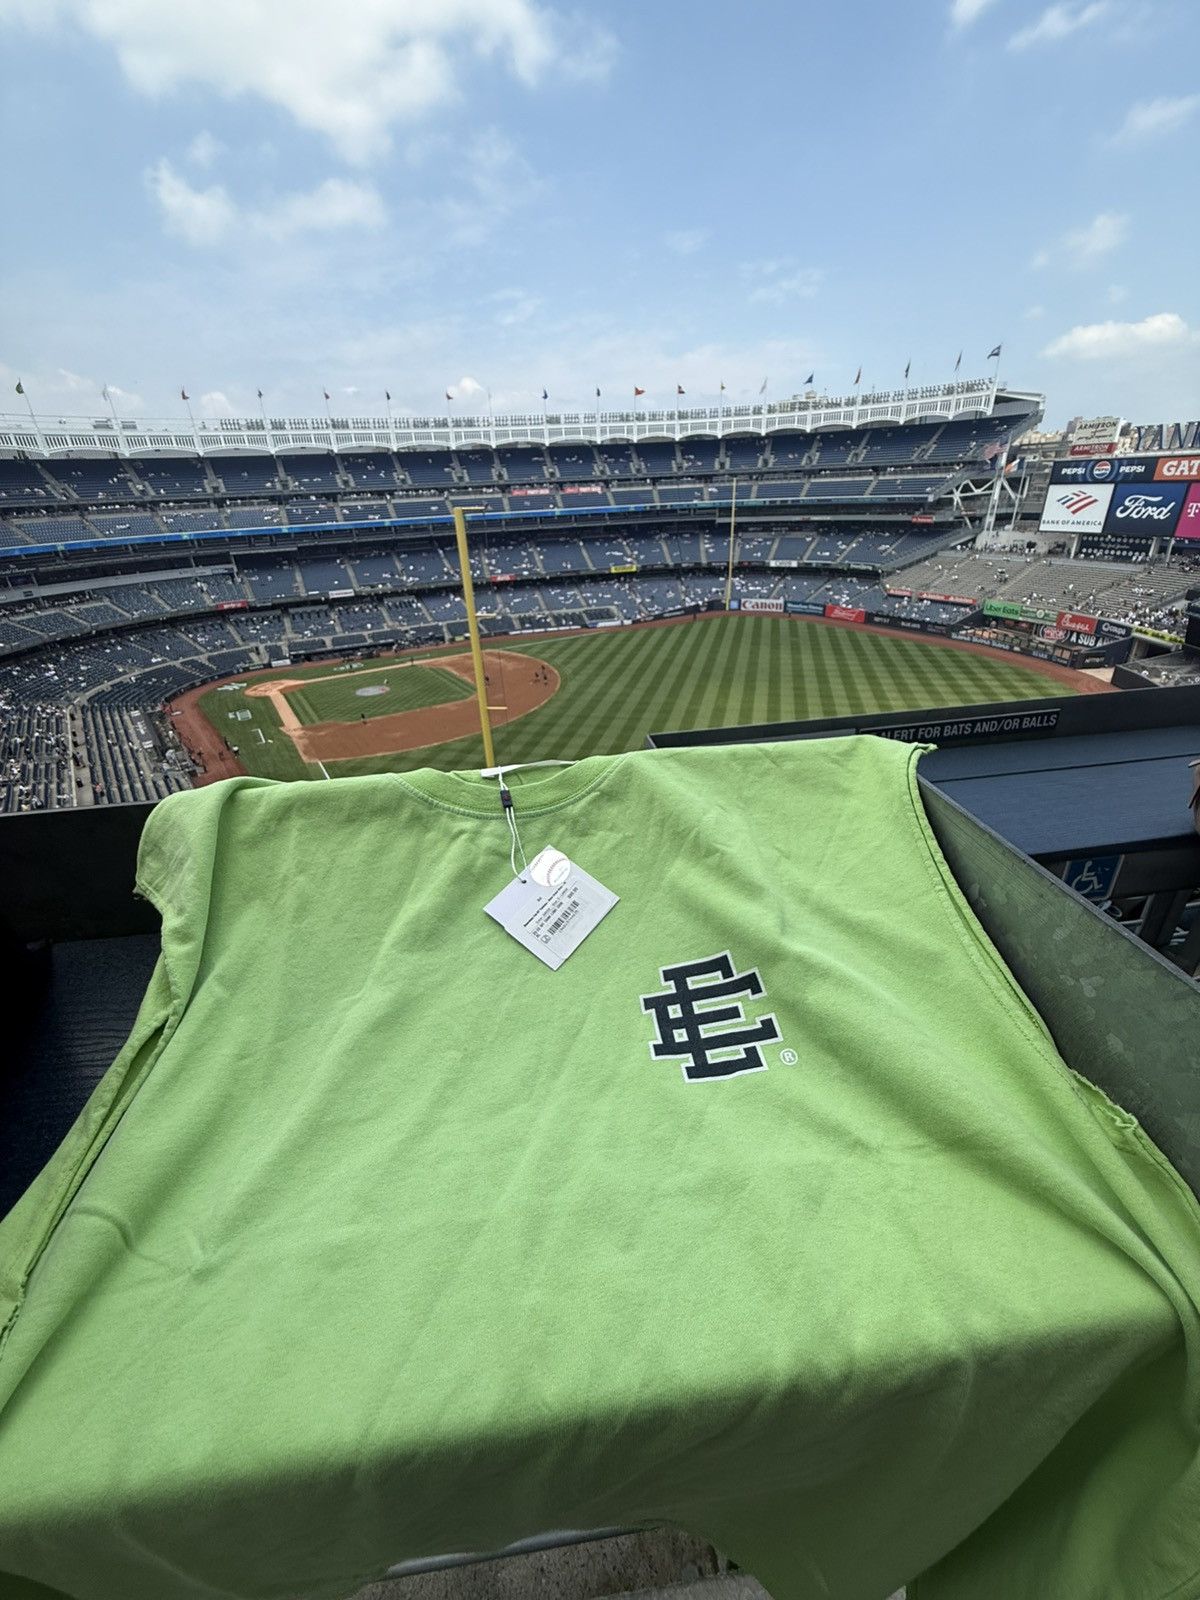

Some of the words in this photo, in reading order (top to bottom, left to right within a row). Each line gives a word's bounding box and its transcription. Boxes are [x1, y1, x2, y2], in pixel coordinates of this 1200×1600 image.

[1061, 467, 1086, 475] PEPSI
[1119, 465, 1146, 473] PEPSI
[1116, 494, 1176, 520] Ford
[742, 599, 783, 611] Canon
[985, 603, 1001, 612] Uber
[1002, 606, 1019, 615] Eats
[1070, 632, 1077, 643] A
[1078, 634, 1096, 647] SUB
[918, 726, 941, 739] FOR
[943, 723, 972, 737] BATS
[975, 718, 1021, 734] AND/OR
[1022, 714, 1057, 729] BALLS
